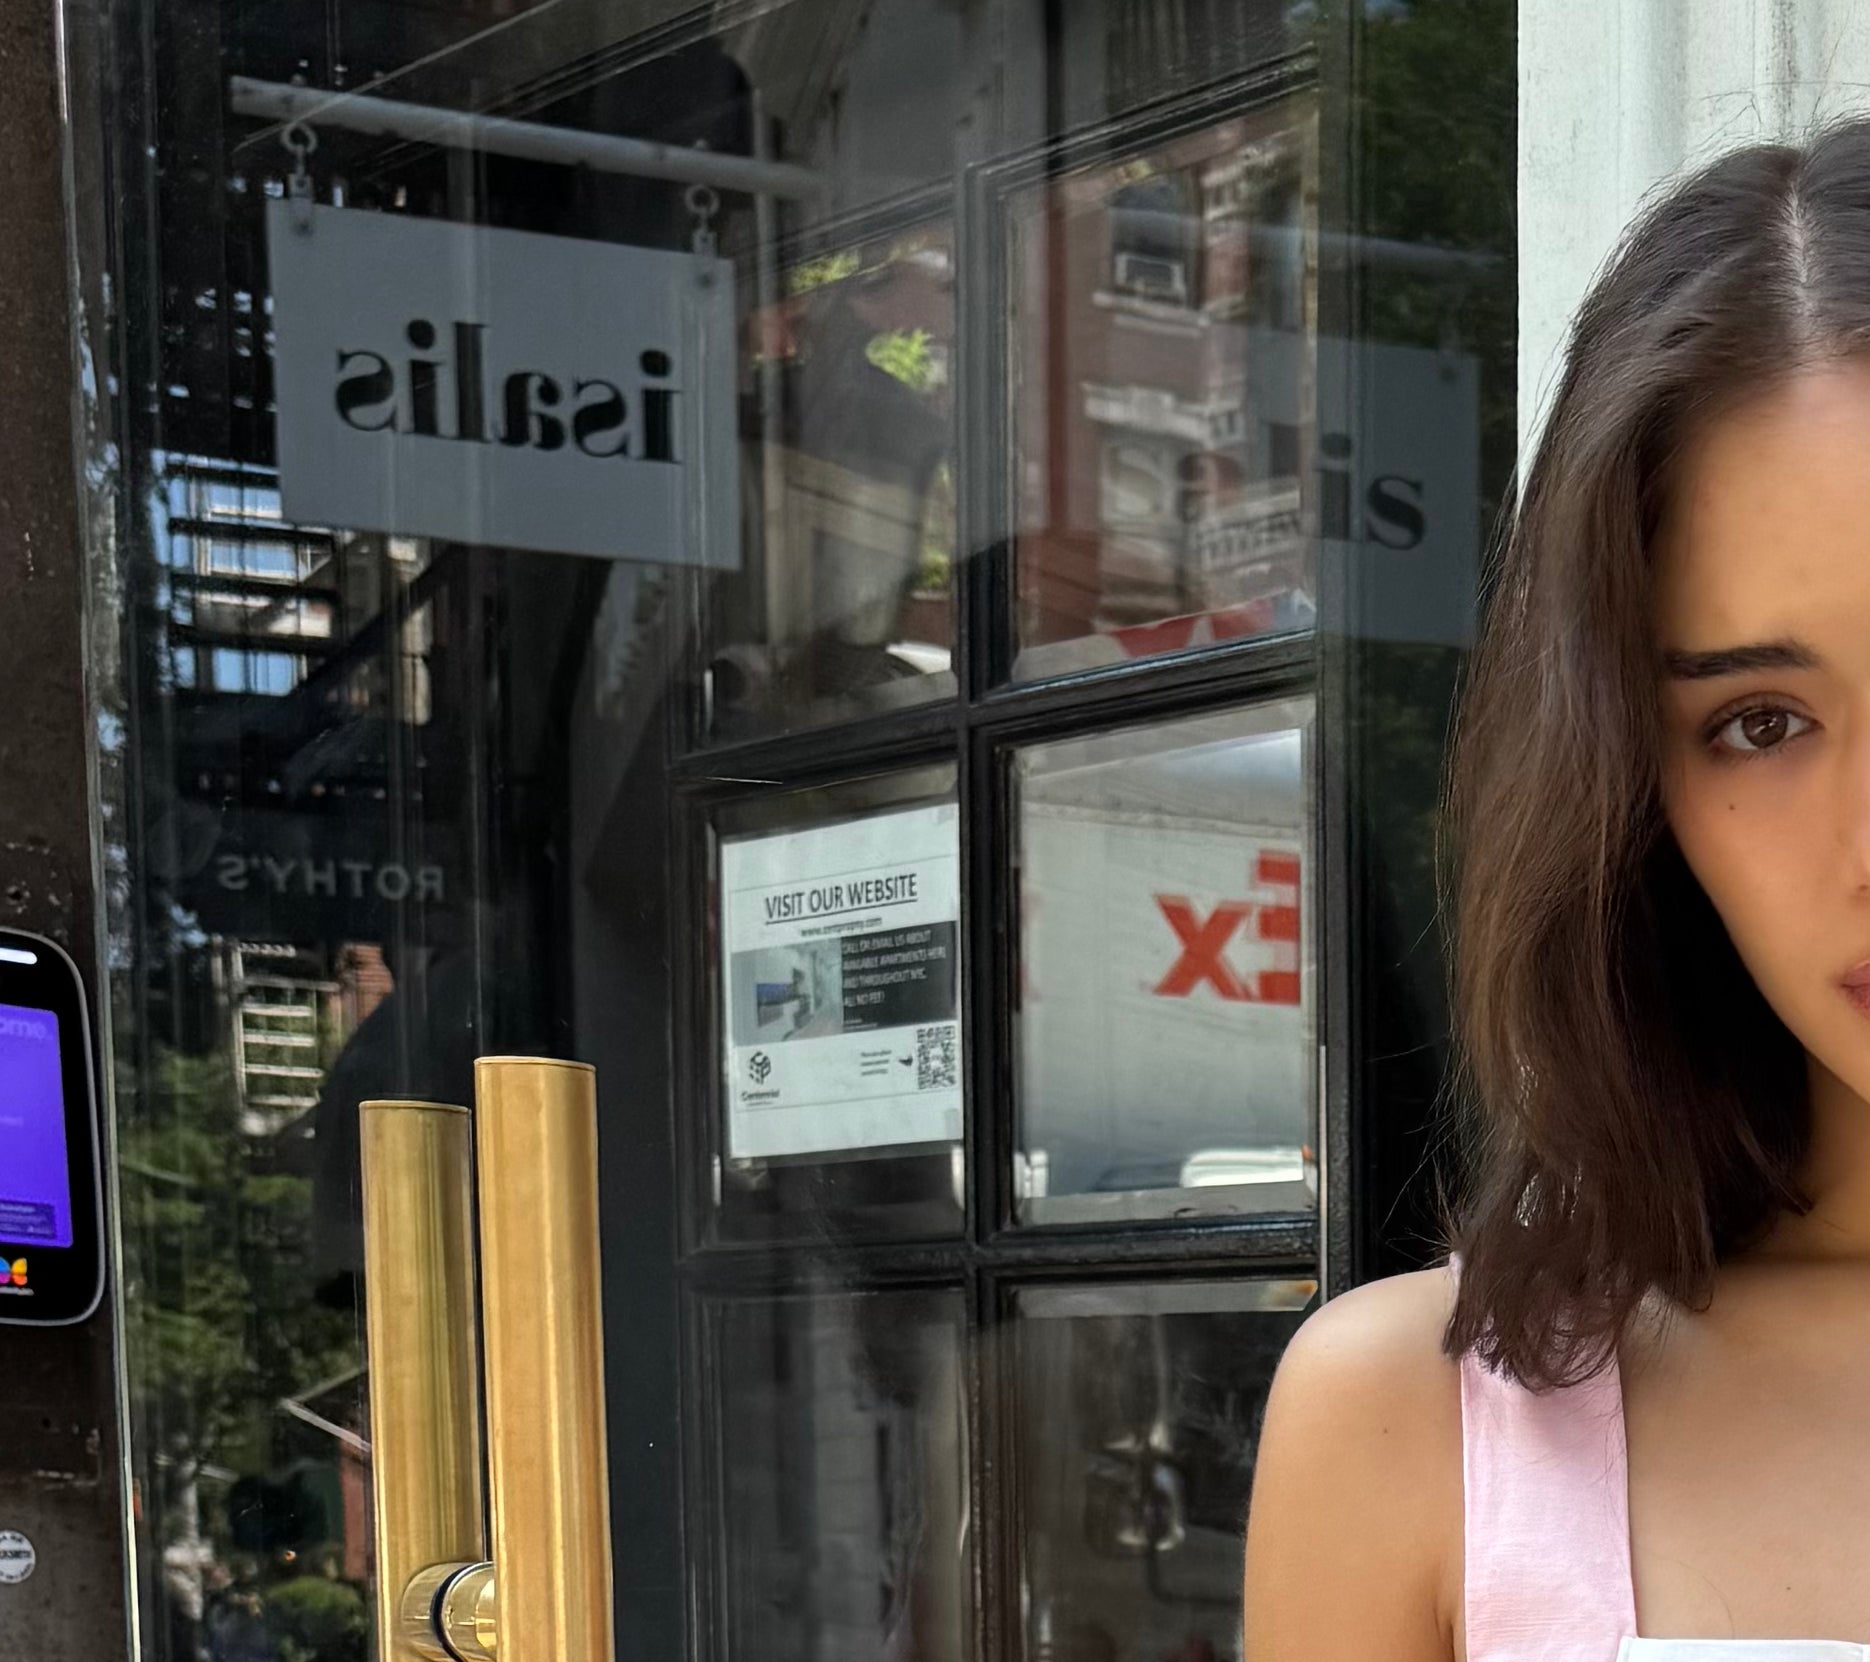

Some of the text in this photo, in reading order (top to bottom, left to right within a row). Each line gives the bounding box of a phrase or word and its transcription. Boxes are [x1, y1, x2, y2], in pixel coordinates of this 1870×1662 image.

[765, 873, 917, 919] VISIT OUR WEBSITE
